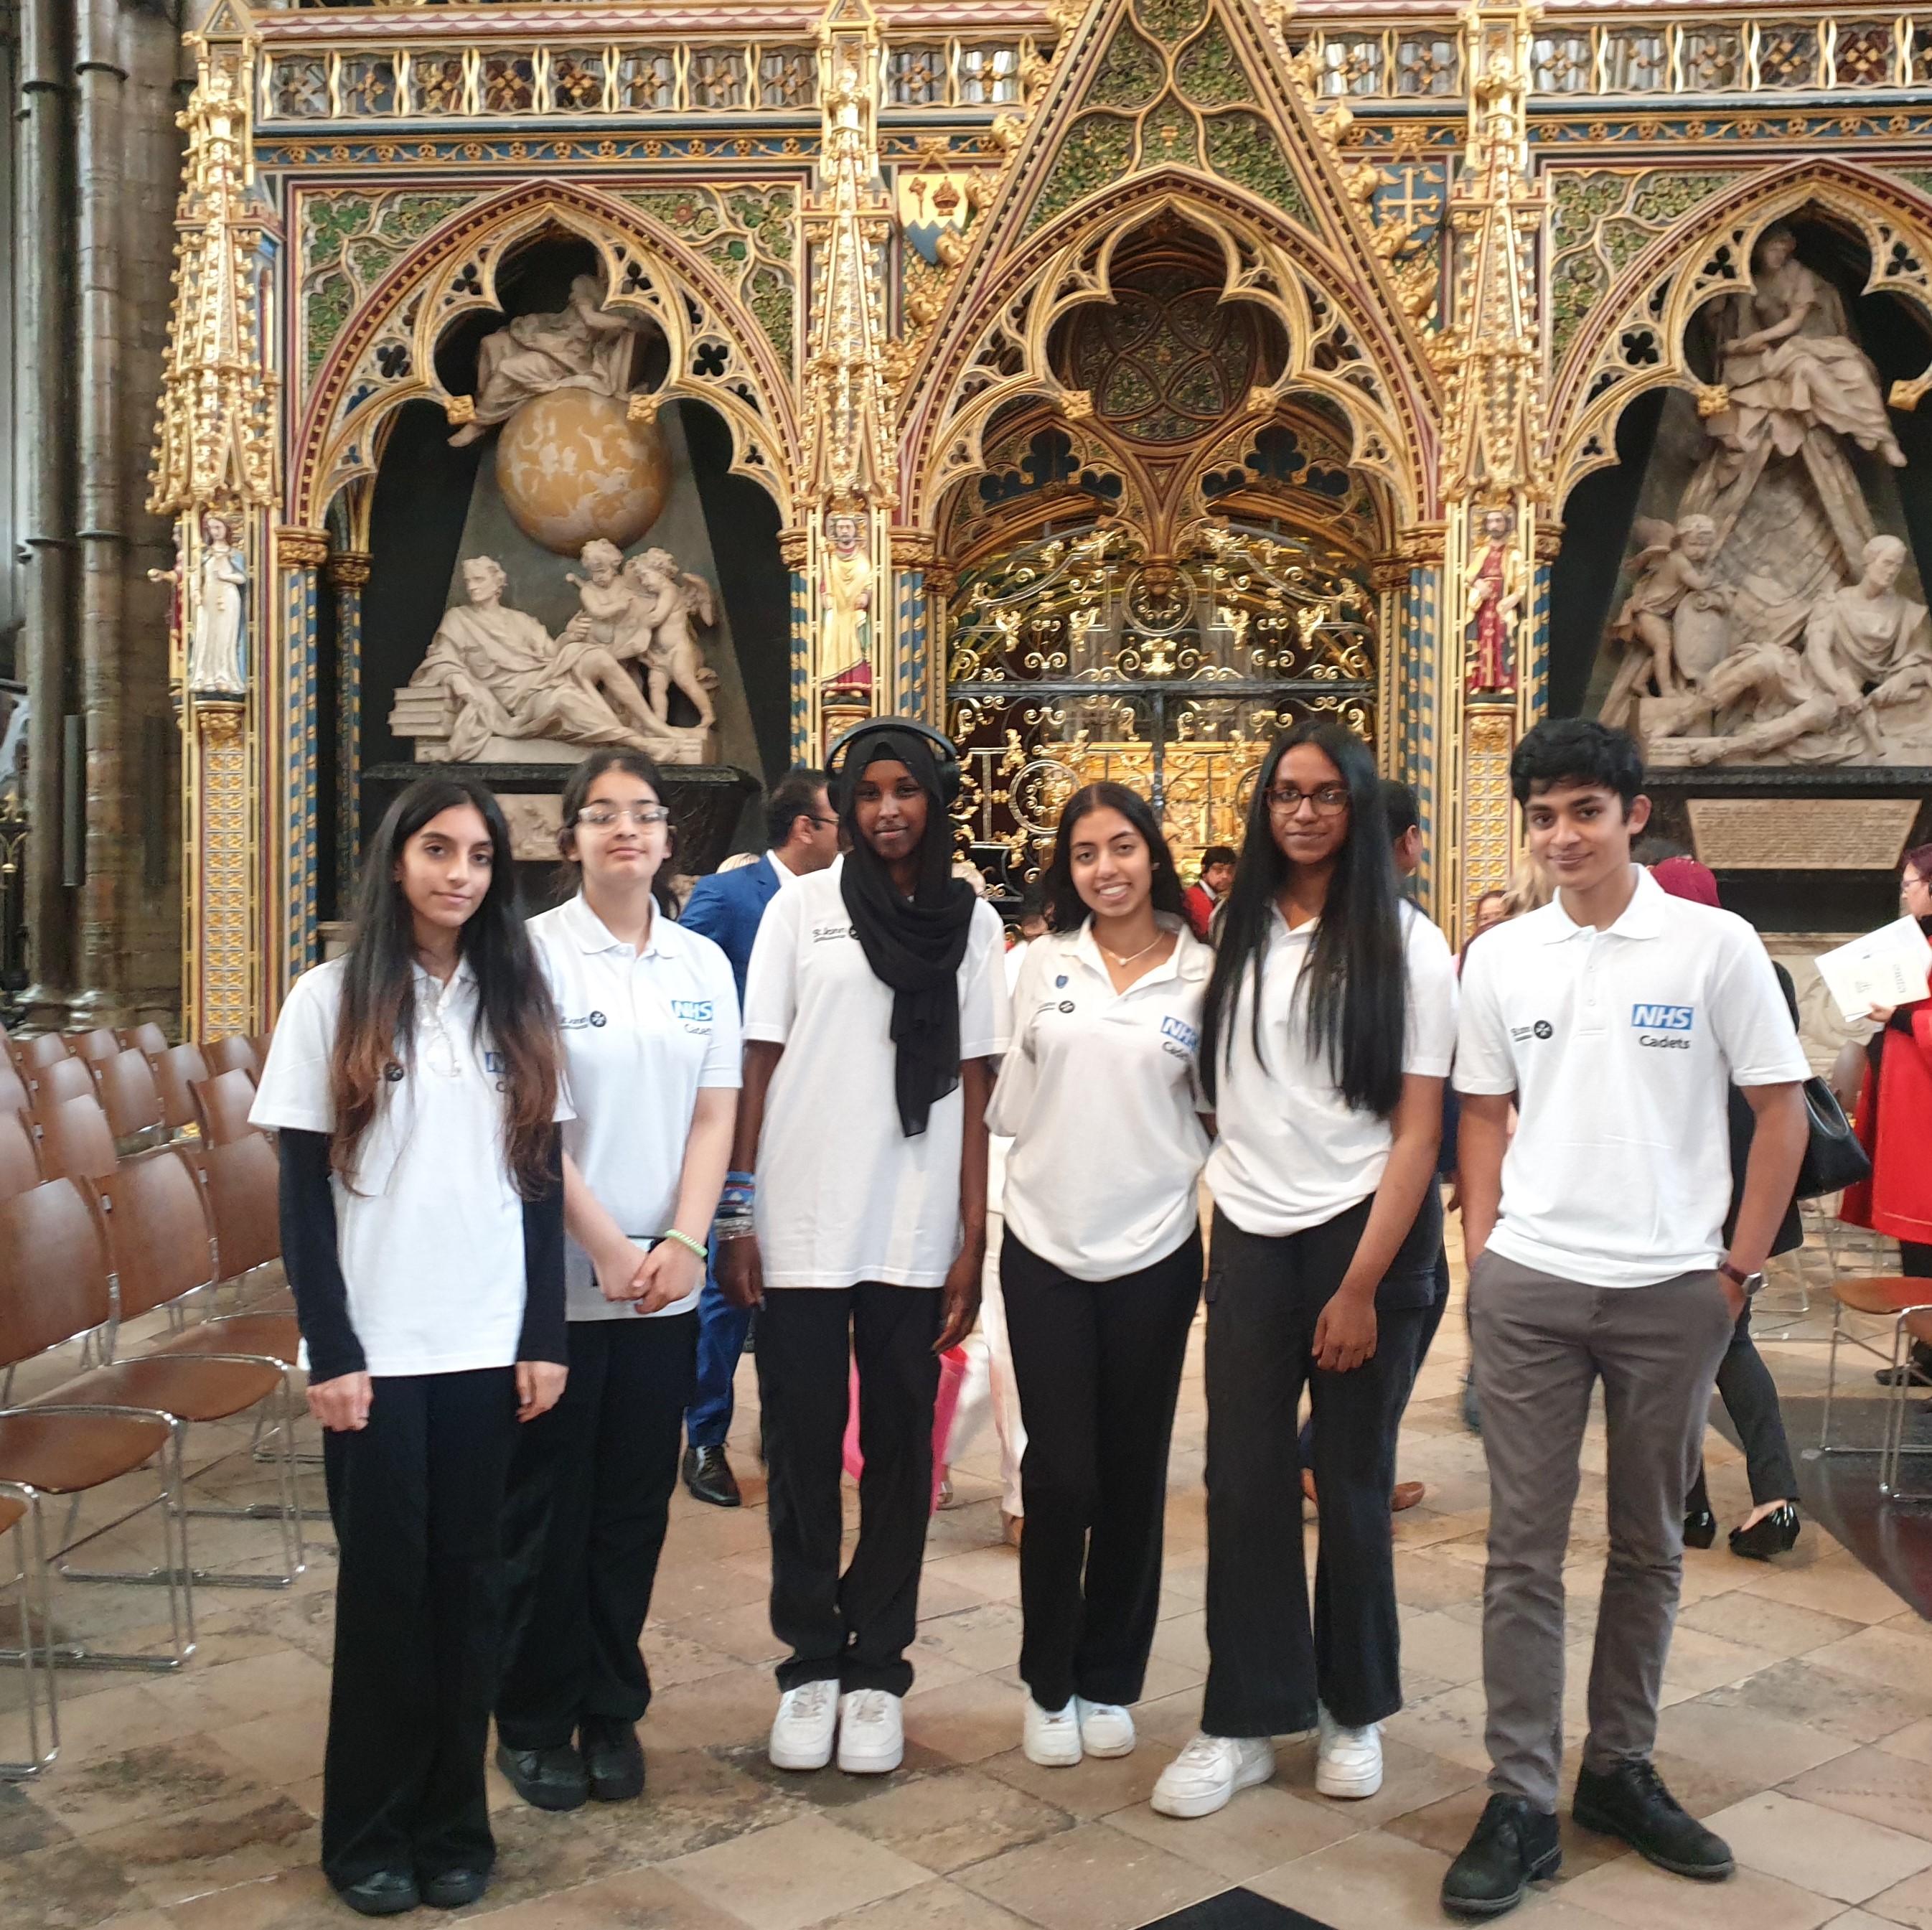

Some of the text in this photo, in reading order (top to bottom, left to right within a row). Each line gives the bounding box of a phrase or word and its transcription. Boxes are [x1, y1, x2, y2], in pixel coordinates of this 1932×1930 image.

[673, 1002, 713, 1021] NHS
[1632, 1005, 1692, 1029] NHS
[1638, 1034, 1691, 1049] Cadets
